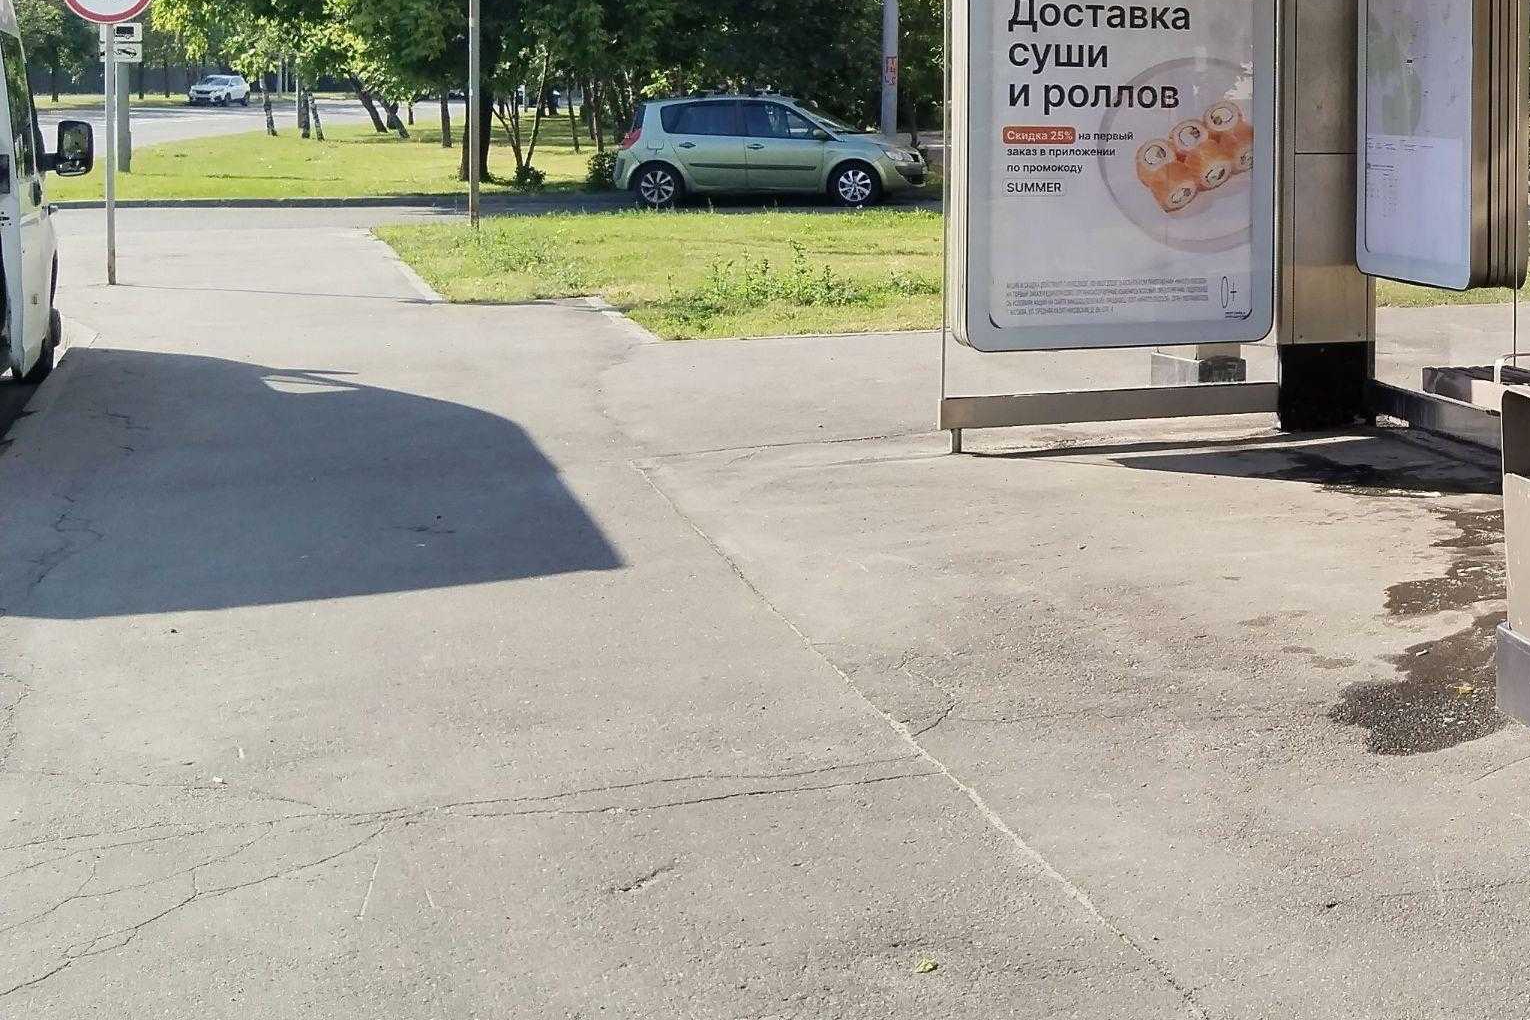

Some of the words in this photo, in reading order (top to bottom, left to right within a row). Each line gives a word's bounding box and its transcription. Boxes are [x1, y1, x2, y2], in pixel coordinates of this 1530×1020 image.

[1008, 42, 1108, 75] суши
[1008, 83, 1030, 107] и
[1043, 84, 1180, 115] роллов
[1006, 130, 1048, 142] Скидка
[1049, 130, 1074, 141] 25%
[1078, 132, 1091, 141] на
[1093, 132, 1134, 143] первый
[1006, 148, 1038, 156] заказ
[1040, 148, 1046, 156] в
[1048, 148, 1116, 158] приложении
[1006, 164, 1021, 172] по
[1023, 164, 1083, 175] промокоду
[1006, 182, 1063, 194] SUMMER
